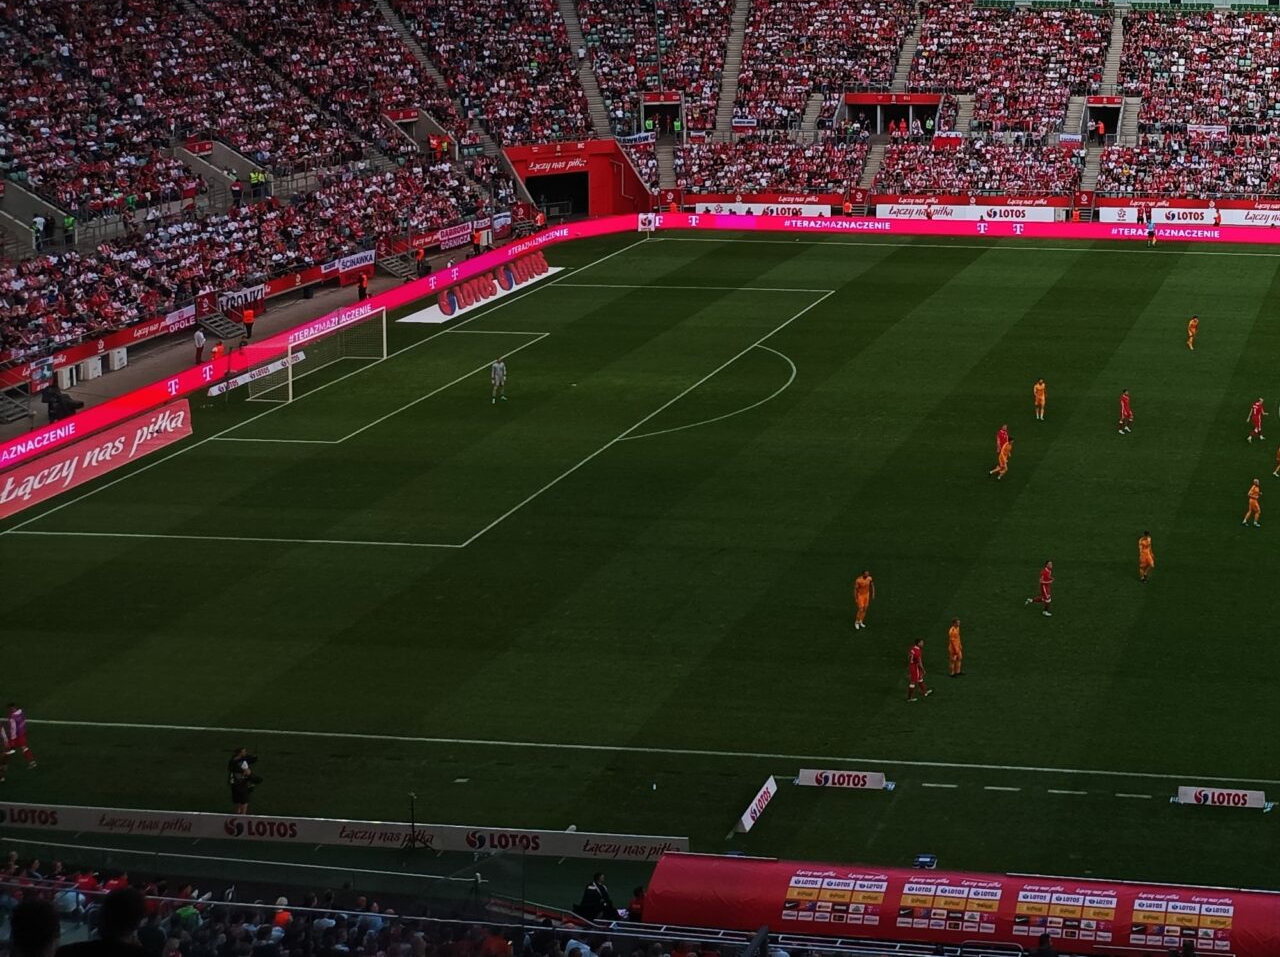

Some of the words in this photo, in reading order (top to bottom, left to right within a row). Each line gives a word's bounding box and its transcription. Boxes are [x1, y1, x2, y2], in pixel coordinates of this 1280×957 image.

[776, 207, 803, 216] LOTOS
[888, 206, 914, 218] Łączy
[931, 207, 954, 220] piłka
[999, 208, 1026, 219] LOTOS
[1177, 210, 1205, 221] LOTOS
[1244, 211, 1270, 224] Łączy
[784, 219, 891, 231] #TERAZMAZNACZENIE
[341, 252, 374, 270] ŚCINAWKA
[511, 251, 549, 286] LOTOS
[455, 273, 497, 310] LOTOS
[169, 316, 196, 333] OPOLE
[255, 366, 271, 379] LOTOS
[167, 377, 180, 395] T
[0, 455, 78, 505] Łączy
[83, 435, 126, 468] nas
[129, 409, 185, 458] piłka
[832, 773, 867, 787] LOTOS
[755, 787, 771, 812] LOTOS
[1211, 792, 1248, 807] LOTOS
[10, 808, 58, 826] LOTOS
[99, 813, 136, 832] Łączy
[137, 818, 160, 831] nas
[160, 817, 192, 834] piłka
[246, 820, 297, 839] LOTOS
[339, 824, 376, 845] Łączy
[378, 829, 400, 842] nas
[401, 830, 434, 850] piłka
[489, 833, 541, 851] LOTOS
[583, 838, 621, 858] Łączy
[623, 844, 646, 856] nas
